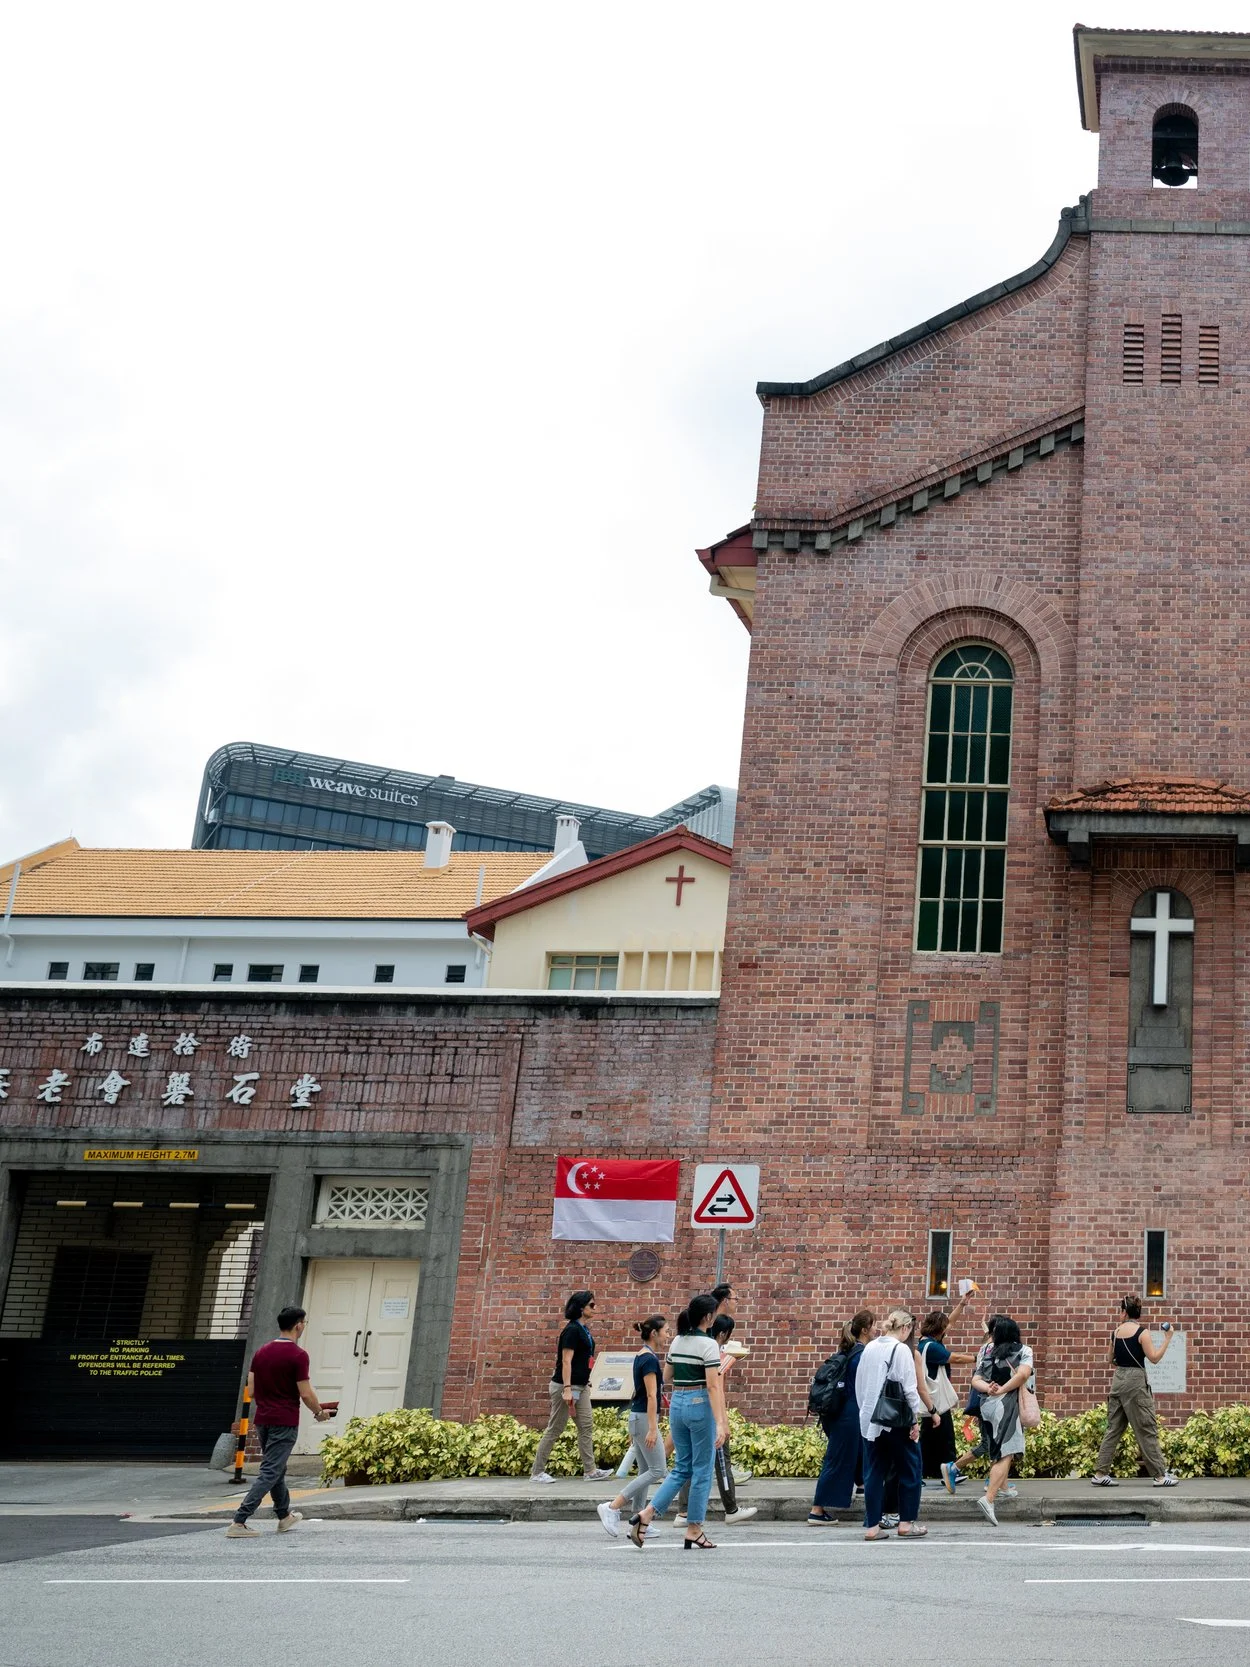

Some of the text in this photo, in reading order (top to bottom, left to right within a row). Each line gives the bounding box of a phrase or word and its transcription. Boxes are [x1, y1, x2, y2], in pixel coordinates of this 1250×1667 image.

[309, 776, 419, 807] weave suites
[87, 1151, 196, 1159] MAXIMUM HEIGHT 2.7M
